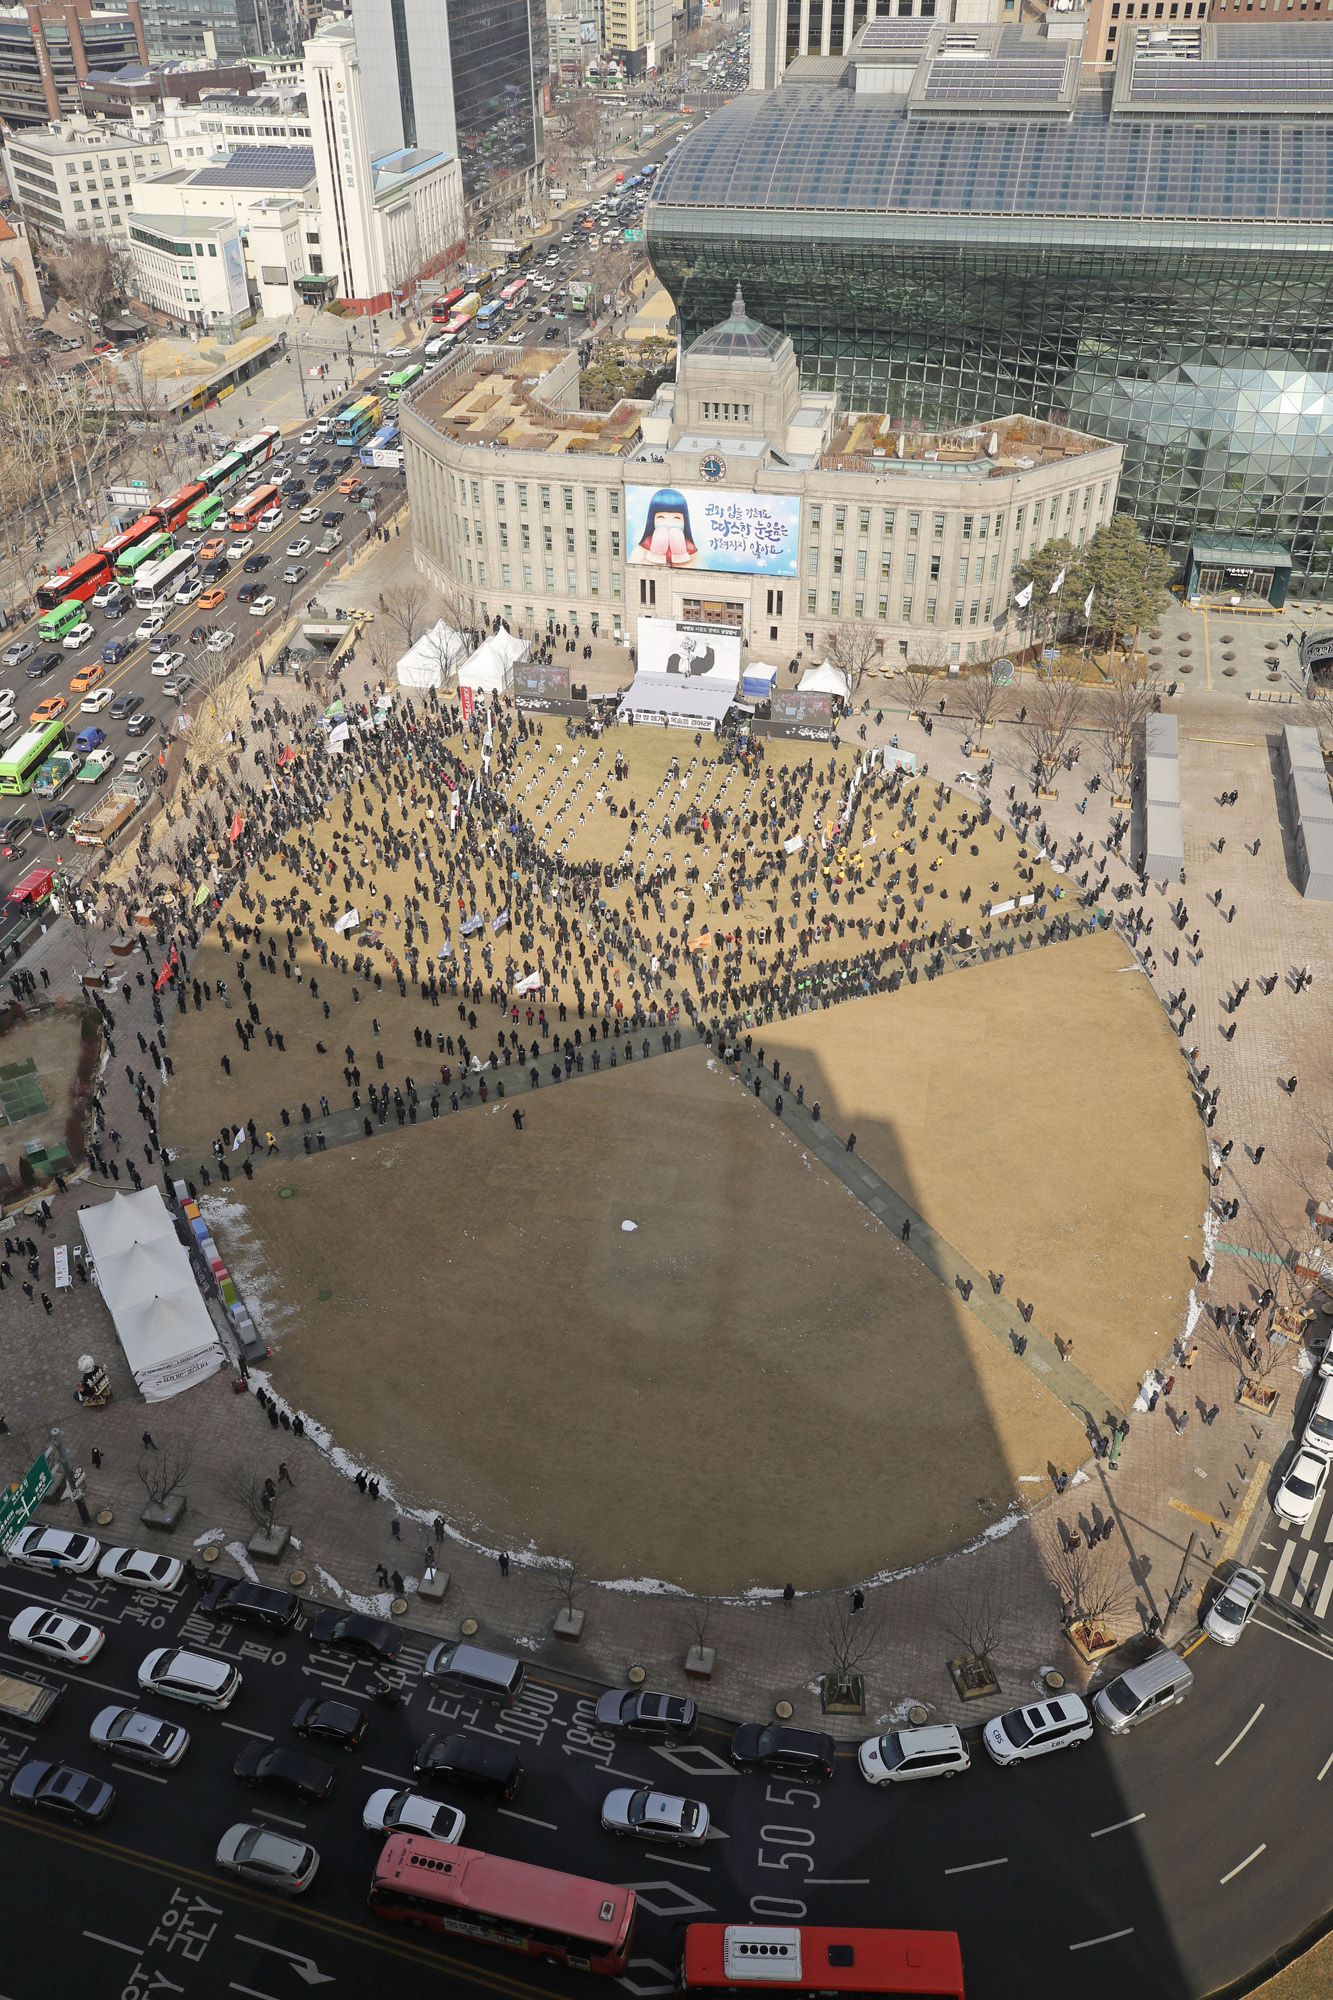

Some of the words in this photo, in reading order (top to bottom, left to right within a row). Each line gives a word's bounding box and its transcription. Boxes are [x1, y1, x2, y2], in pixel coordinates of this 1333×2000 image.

[339, 98, 354, 188] 서울특별시의회
[704, 503, 726, 519] 코와
[726, 503, 743, 521] 입을
[745, 506, 772, 520] 가려도
[710, 518, 752, 540] 따스한
[707, 538, 747, 552] 가려지지
[749, 541, 784, 560] 않아요
[61, 1576, 117, 1610] 덕수
[494, 1682, 559, 1746] 10:00
[758, 1824, 815, 1872] 50
